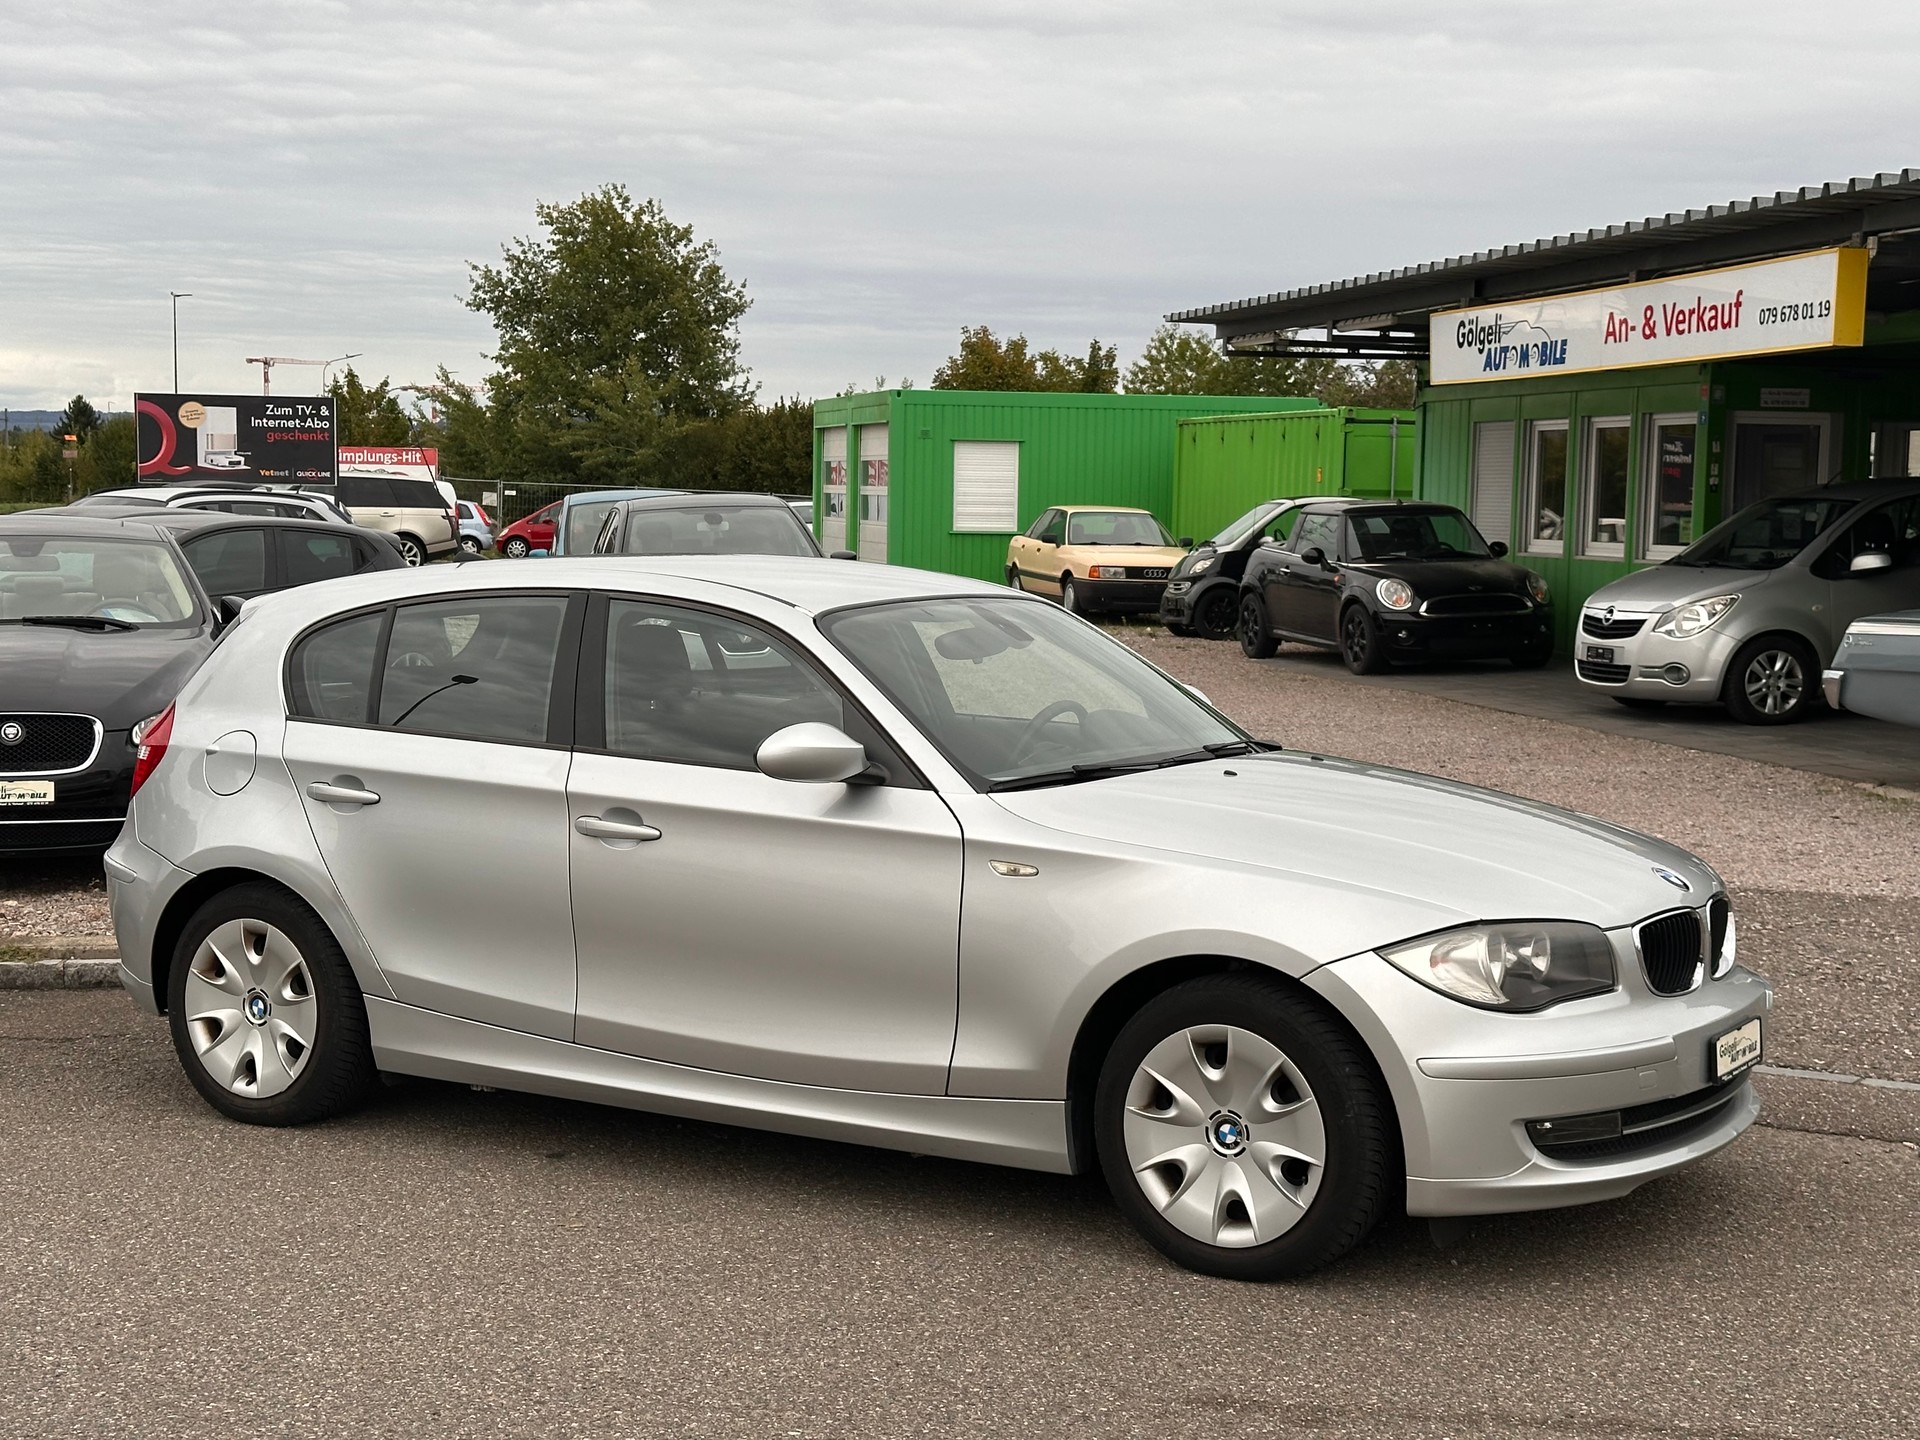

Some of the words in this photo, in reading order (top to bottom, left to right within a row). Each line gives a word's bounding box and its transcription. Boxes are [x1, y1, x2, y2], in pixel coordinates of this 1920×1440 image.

[1604, 312, 1637, 344] An-
[1642, 304, 1657, 340] &
[1662, 289, 1743, 337] Verkauf
[1759, 307, 1778, 326] 079
[1780, 304, 1799, 322] 678
[1802, 301, 1814, 320] 01
[1818, 299, 1831, 318] 19
[1457, 313, 1502, 355] Gölgeli
[265, 404, 293, 415] Zum
[296, 404, 317, 415] TV-
[320, 405, 330, 416] &
[251, 416, 330, 429] Internet-Abo
[266, 430, 330, 443] geschenkt
[259, 469, 289, 477] Yetnet
